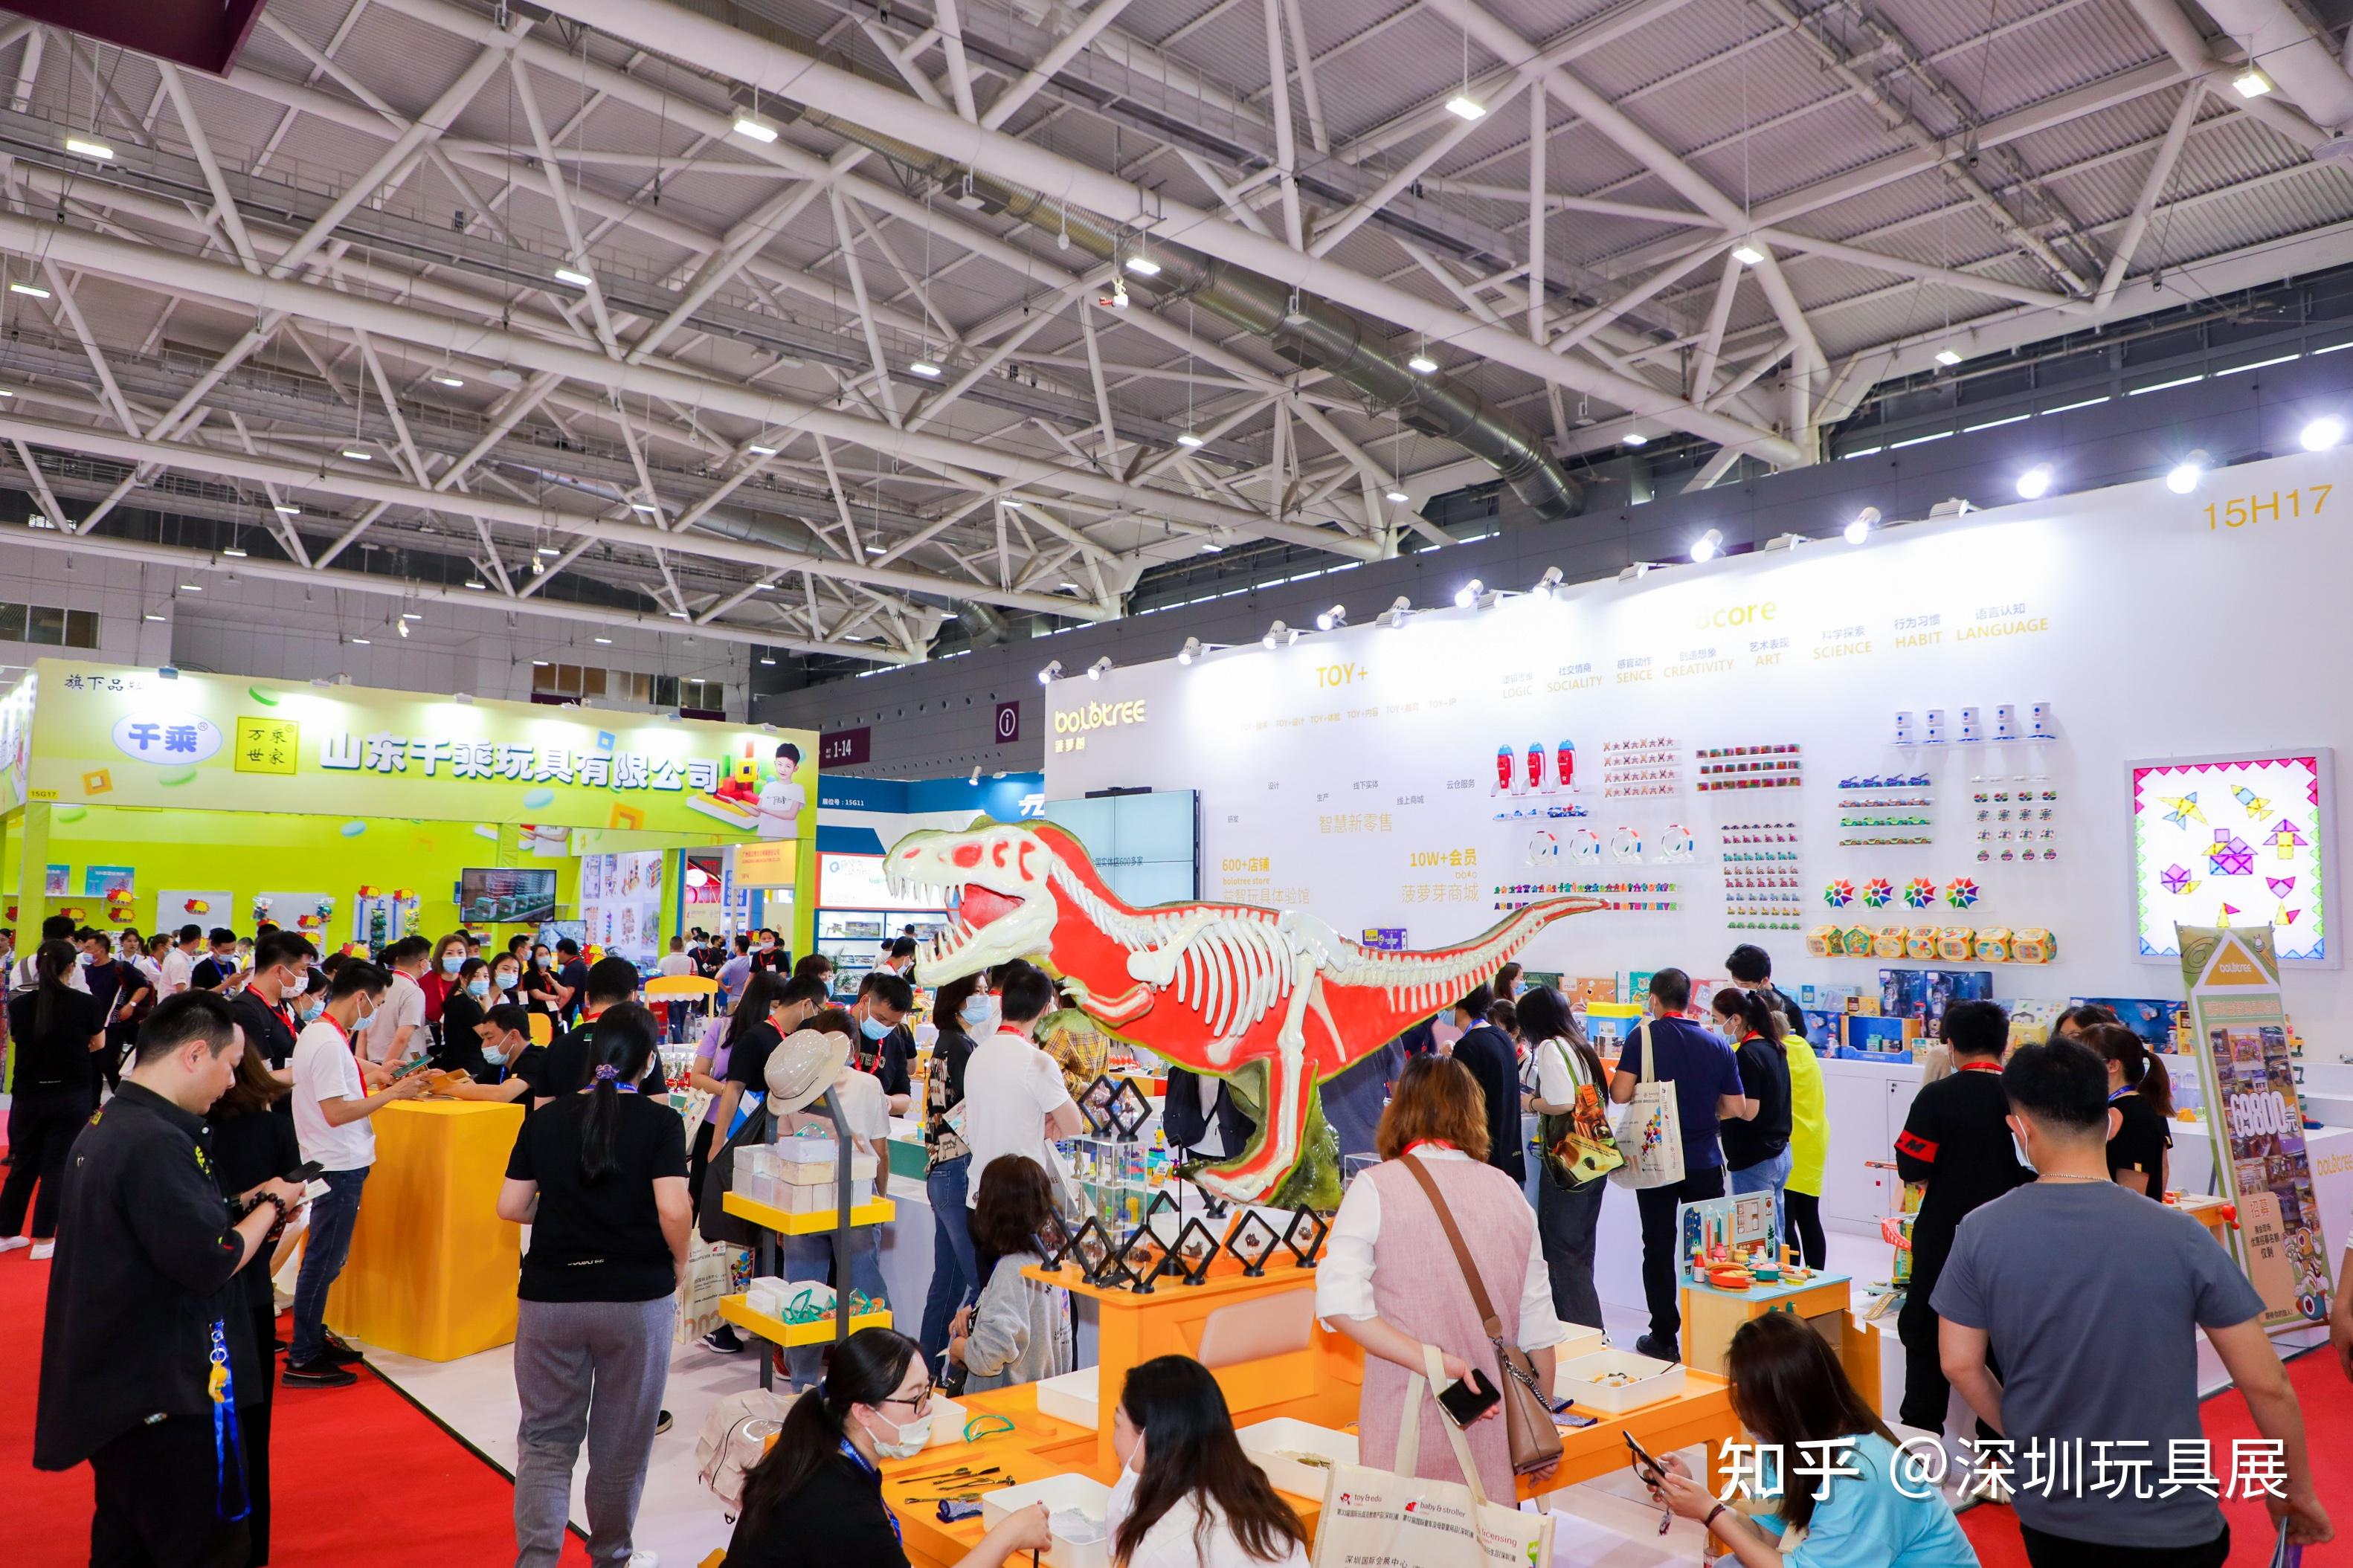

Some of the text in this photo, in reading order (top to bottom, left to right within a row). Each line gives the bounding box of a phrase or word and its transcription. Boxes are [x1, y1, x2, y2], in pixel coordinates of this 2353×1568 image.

[2203, 484, 2334, 530] 15H17
[1975, 603, 2027, 620] 语言认知
[1893, 613, 1941, 630] 行为习惯
[1956, 618, 2049, 641] LANGUAGE
[1821, 625, 1866, 642] 科学探索
[1894, 630, 1943, 648] HABIT
[1748, 637, 1790, 653] 艺术表现
[1813, 641, 1873, 660] SCIENCE
[1617, 656, 1653, 670] 感官动作
[1679, 648, 1717, 662] 创造想象
[1754, 653, 1782, 667] ART
[1316, 662, 1368, 688] TOY+
[1559, 662, 1591, 676] 社交情商
[1616, 669, 1653, 684] SENCE
[1663, 659, 1735, 679] CREATIVITY
[64, 674, 144, 691] 旗下品
[1546, 676, 1603, 694] SOCIALITY
[1502, 685, 1534, 700] LOGIC
[1055, 700, 1147, 733] bolotree
[128, 723, 198, 753] 千乘
[834, 739, 852, 758] 1-14
[319, 732, 720, 795] 山东千乘玩具有限公司
[1353, 779, 1379, 791] 线下实体
[1446, 779, 1475, 790] 云仓服务
[30, 790, 57, 798] 15G17
[1316, 793, 1330, 803] 生产
[1397, 794, 1425, 806] 线上商城
[1319, 811, 1393, 833] 智慧新零售
[1222, 856, 1270, 873] 600+店铺
[1409, 848, 1477, 868] 10W+会员
[1224, 887, 1310, 905] 益智玩具体验馆
[1401, 882, 1479, 903] 菠萝芽商城
[2230, 1091, 2299, 1138] 69800元
[2250, 1198, 2270, 1219] 招募
[1420, 1502, 1437, 1511] baby
[1442, 1507, 1467, 1518] stroller
[1481, 1528, 1518, 1548] licensing
